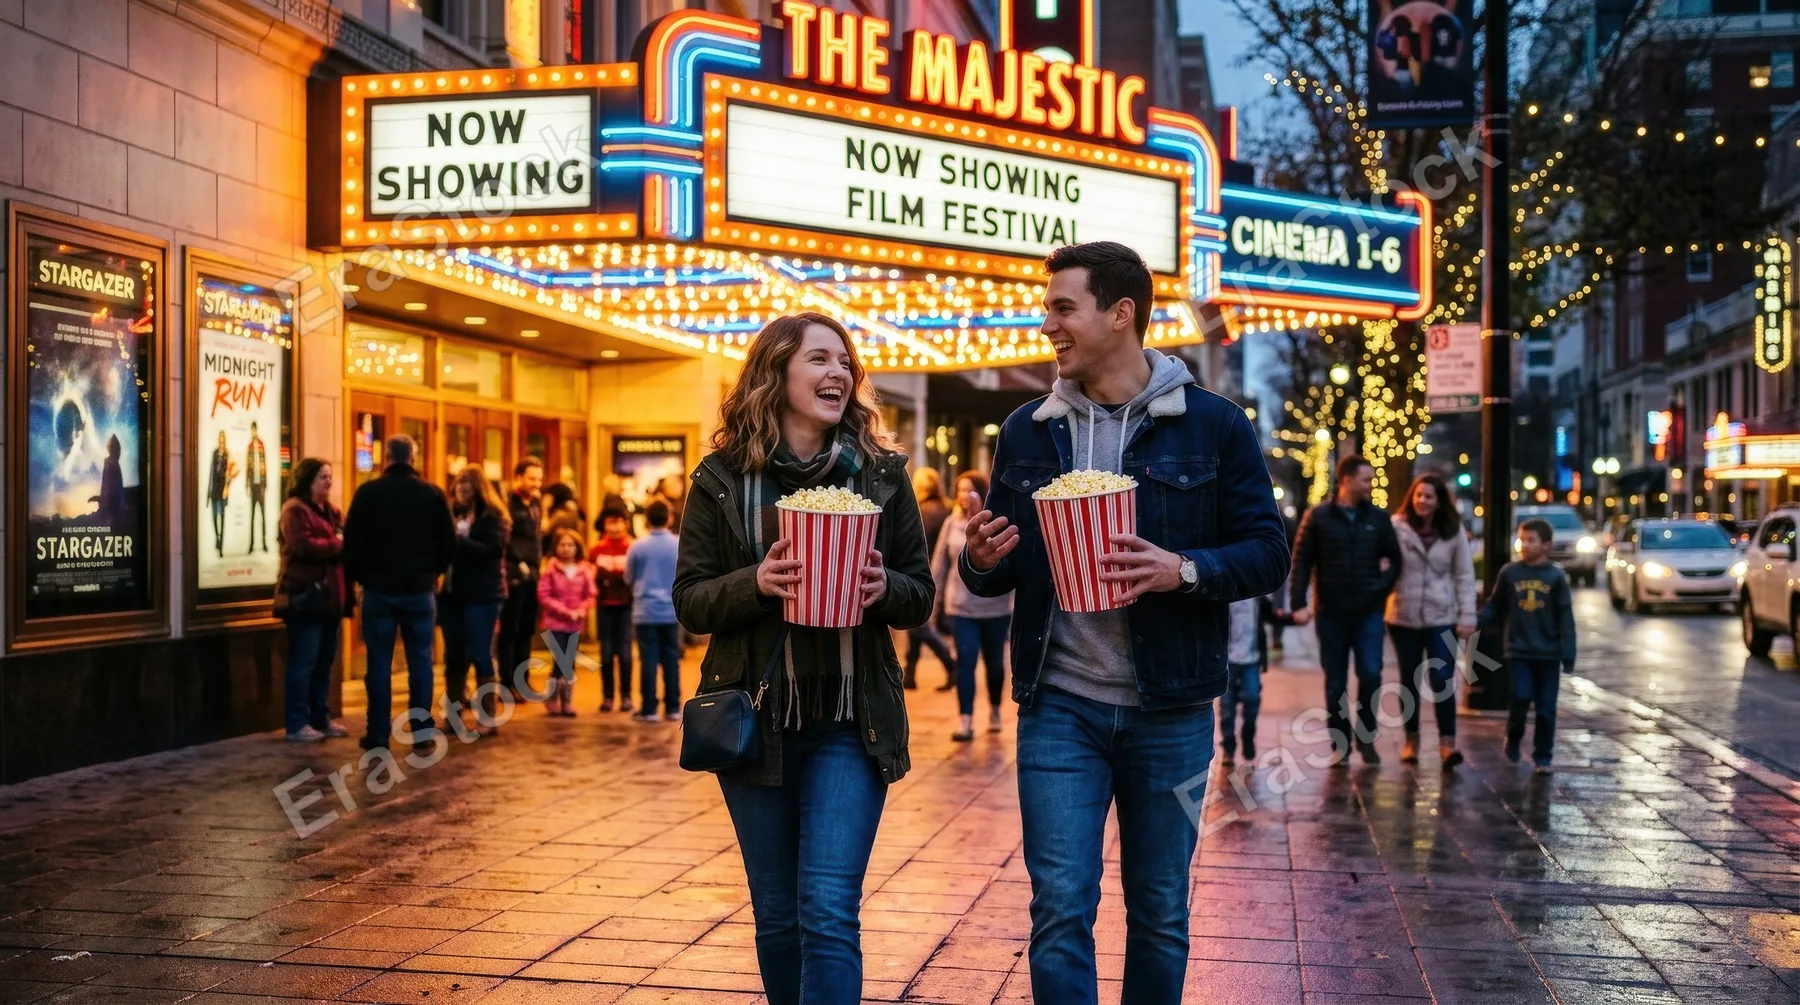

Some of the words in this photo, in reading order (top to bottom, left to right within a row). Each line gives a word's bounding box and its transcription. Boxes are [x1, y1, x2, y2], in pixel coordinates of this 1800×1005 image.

[782, 0, 891, 94] THE
[909, 29, 1146, 145] MAJESTIC
[428, 109, 526, 147] NOW
[377, 160, 584, 201] SHOWING
[845, 137, 921, 179] NOW
[940, 153, 1081, 203] SHOWING
[848, 186, 924, 228] FILM
[1231, 215, 1350, 268] CINEMA
[1356, 232, 1402, 274] 1-6
[39, 259, 135, 300] STARGAZER
[204, 352, 275, 380] MIDNIGHT
[211, 377, 266, 419] RUN
[36, 535, 133, 560] STARGAZER
